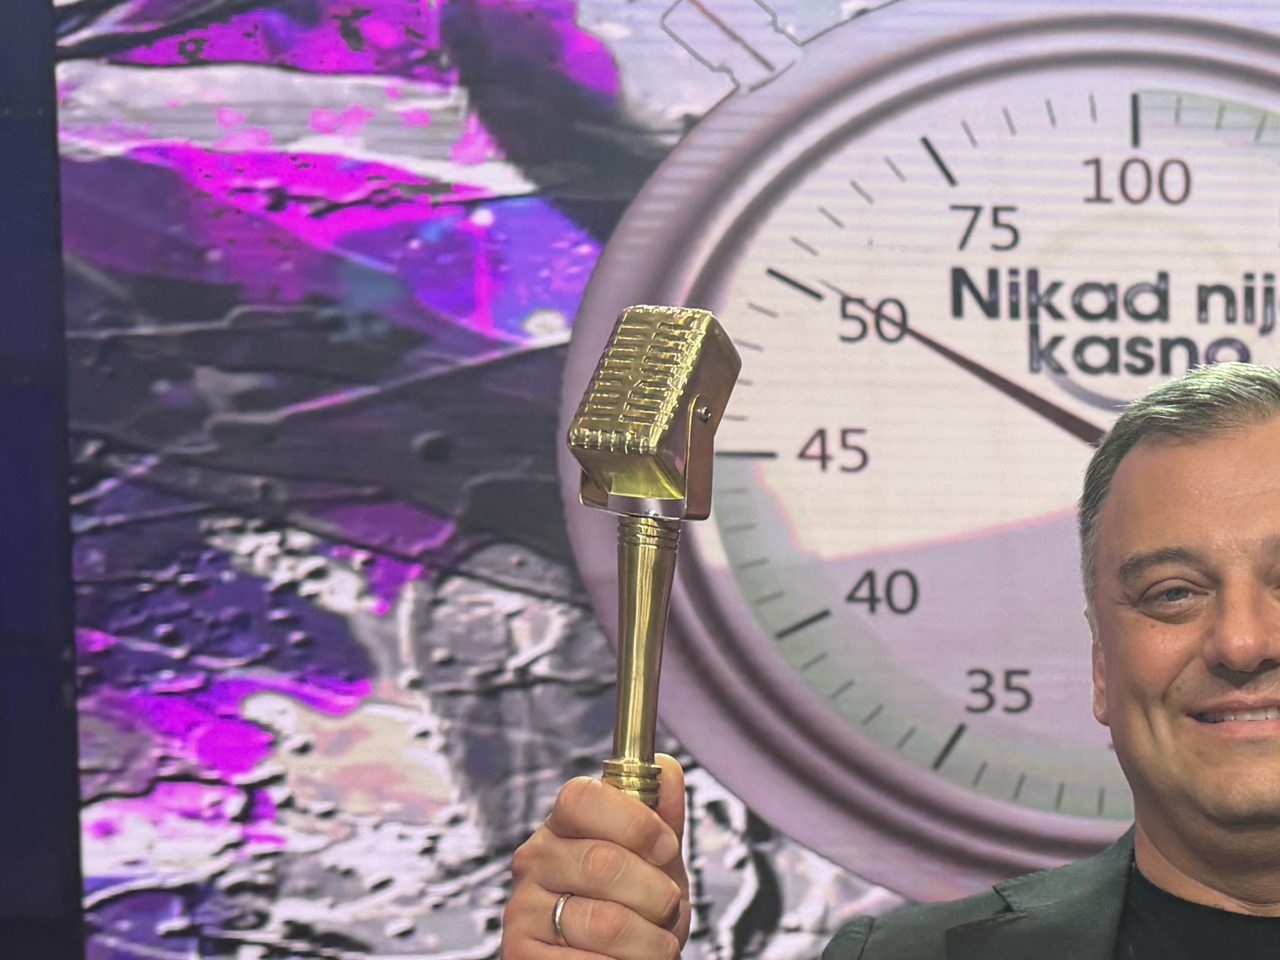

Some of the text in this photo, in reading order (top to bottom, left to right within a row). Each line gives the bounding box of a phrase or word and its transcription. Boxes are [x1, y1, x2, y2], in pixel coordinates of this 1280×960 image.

[1082, 157, 1192, 205] 100
[949, 204, 1021, 251] 75
[951, 267, 1170, 322] Nikad
[838, 297, 909, 343] 50
[1028, 322, 1251, 375] kasno
[797, 427, 870, 473] 45
[845, 569, 920, 616] 40
[964, 669, 1034, 714] 35
